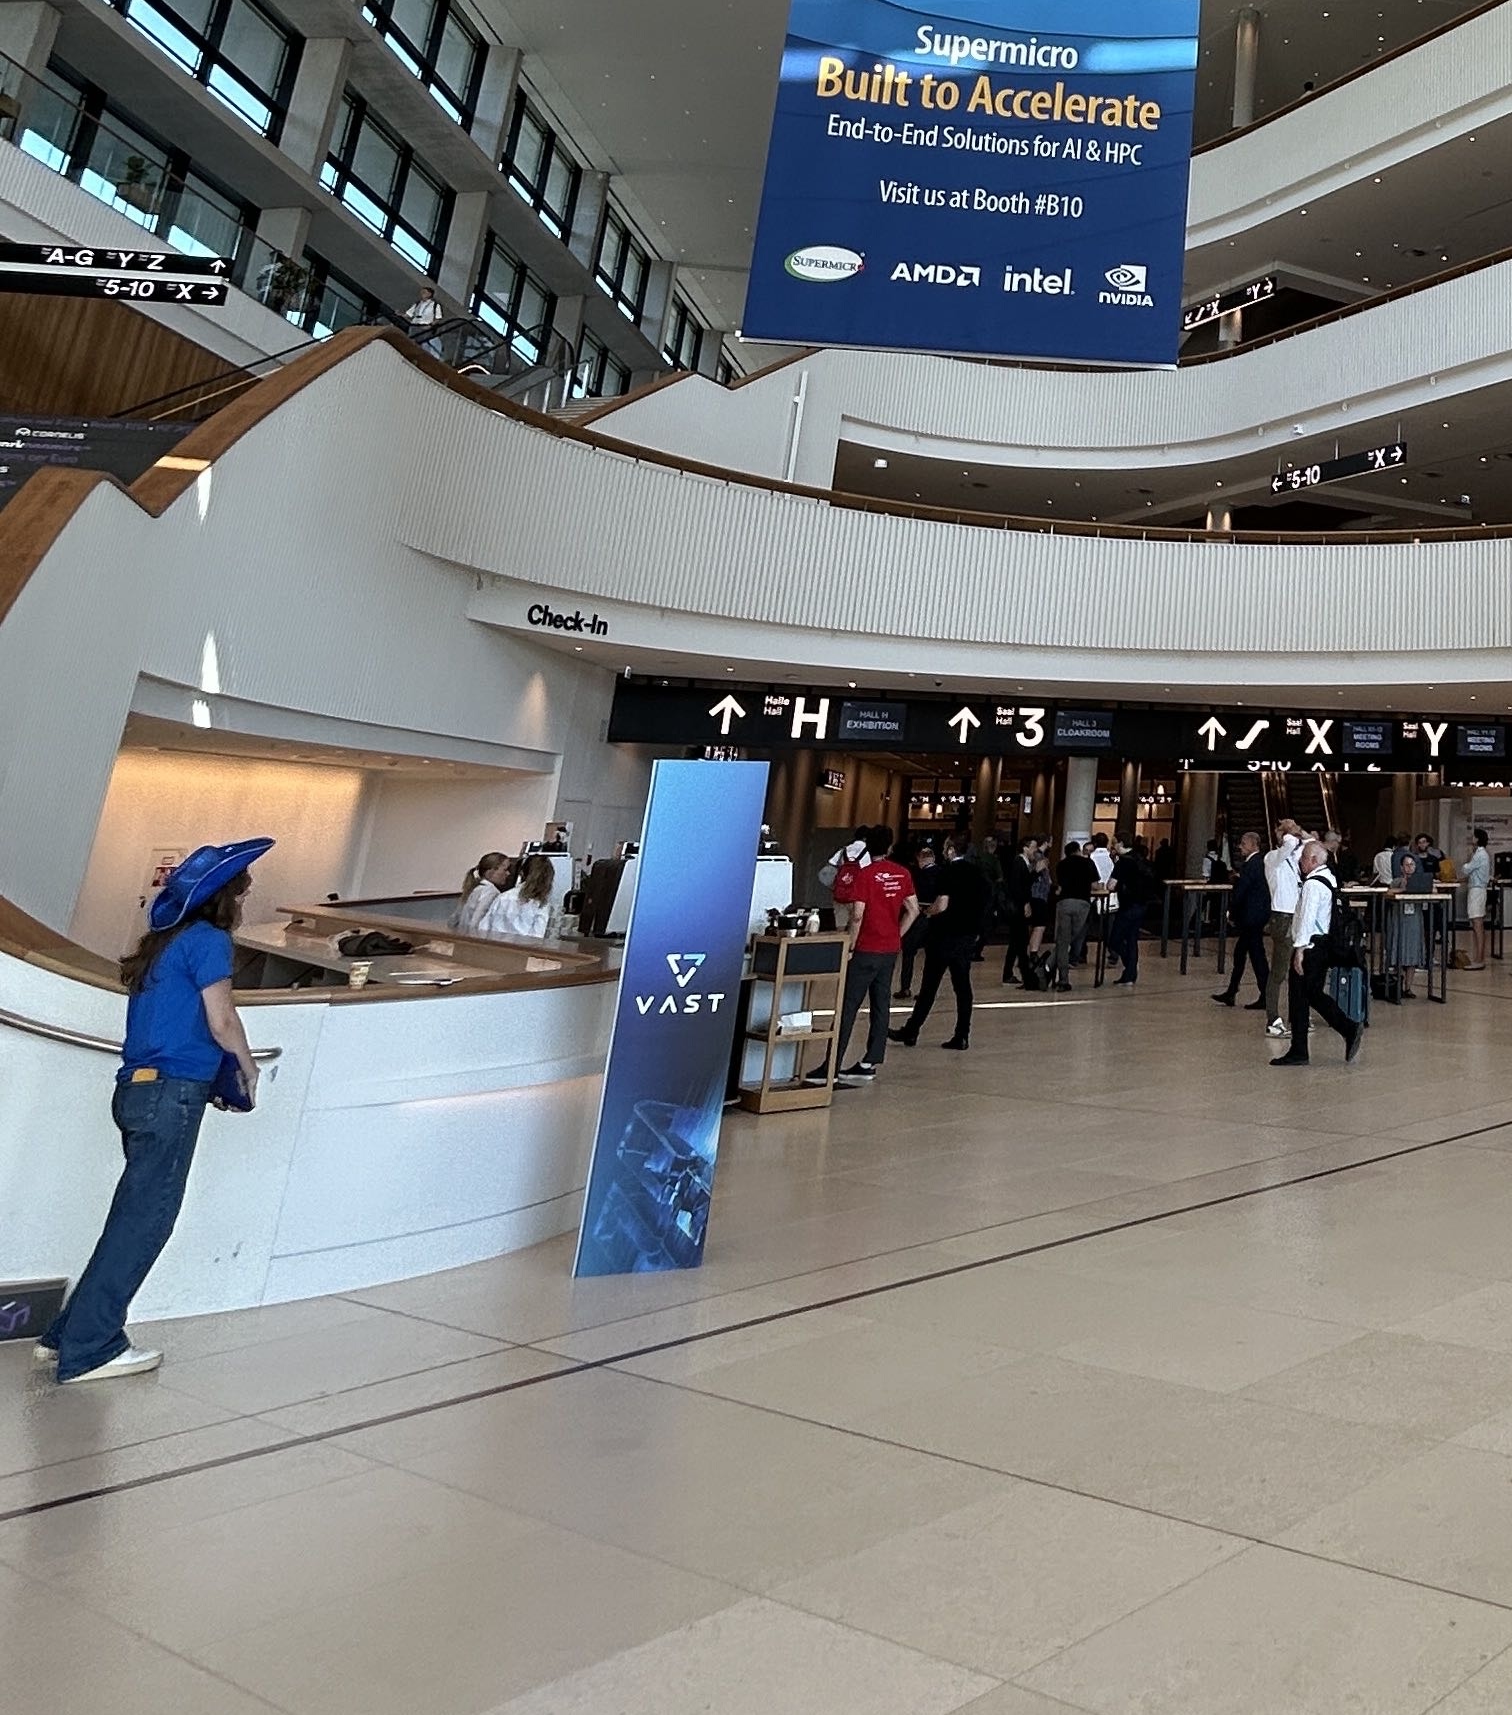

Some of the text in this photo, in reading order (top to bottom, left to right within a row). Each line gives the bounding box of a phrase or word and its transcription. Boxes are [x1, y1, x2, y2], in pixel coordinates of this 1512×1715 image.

[915, 25, 1079, 69] Supermicro
[817, 56, 1161, 130] Built to Accelerate
[827, 113, 1143, 166] End-to-End Solutions for AI & HPC
[879, 180, 1083, 218] Visit us at Booth #B10
[46, 248, 166, 270] A-G Y Z
[890, 262, 956, 285] AMD
[104, 279, 195, 300] 5-10 X
[1252, 283, 1261, 299] Y
[1291, 447, 1386, 489] 5-10 X
[528, 604, 609, 635] Check-In
[790, 697, 830, 739] H
[846, 719, 899, 731] EXHIBITION
[1015, 707, 1046, 748] 3
[1057, 728, 1110, 738] CLOAKROOM
[1286, 726, 1301, 735] Hall
[1304, 718, 1334, 755] X
[1422, 722, 1448, 757] Y
[635, 992, 726, 1015] VAST
